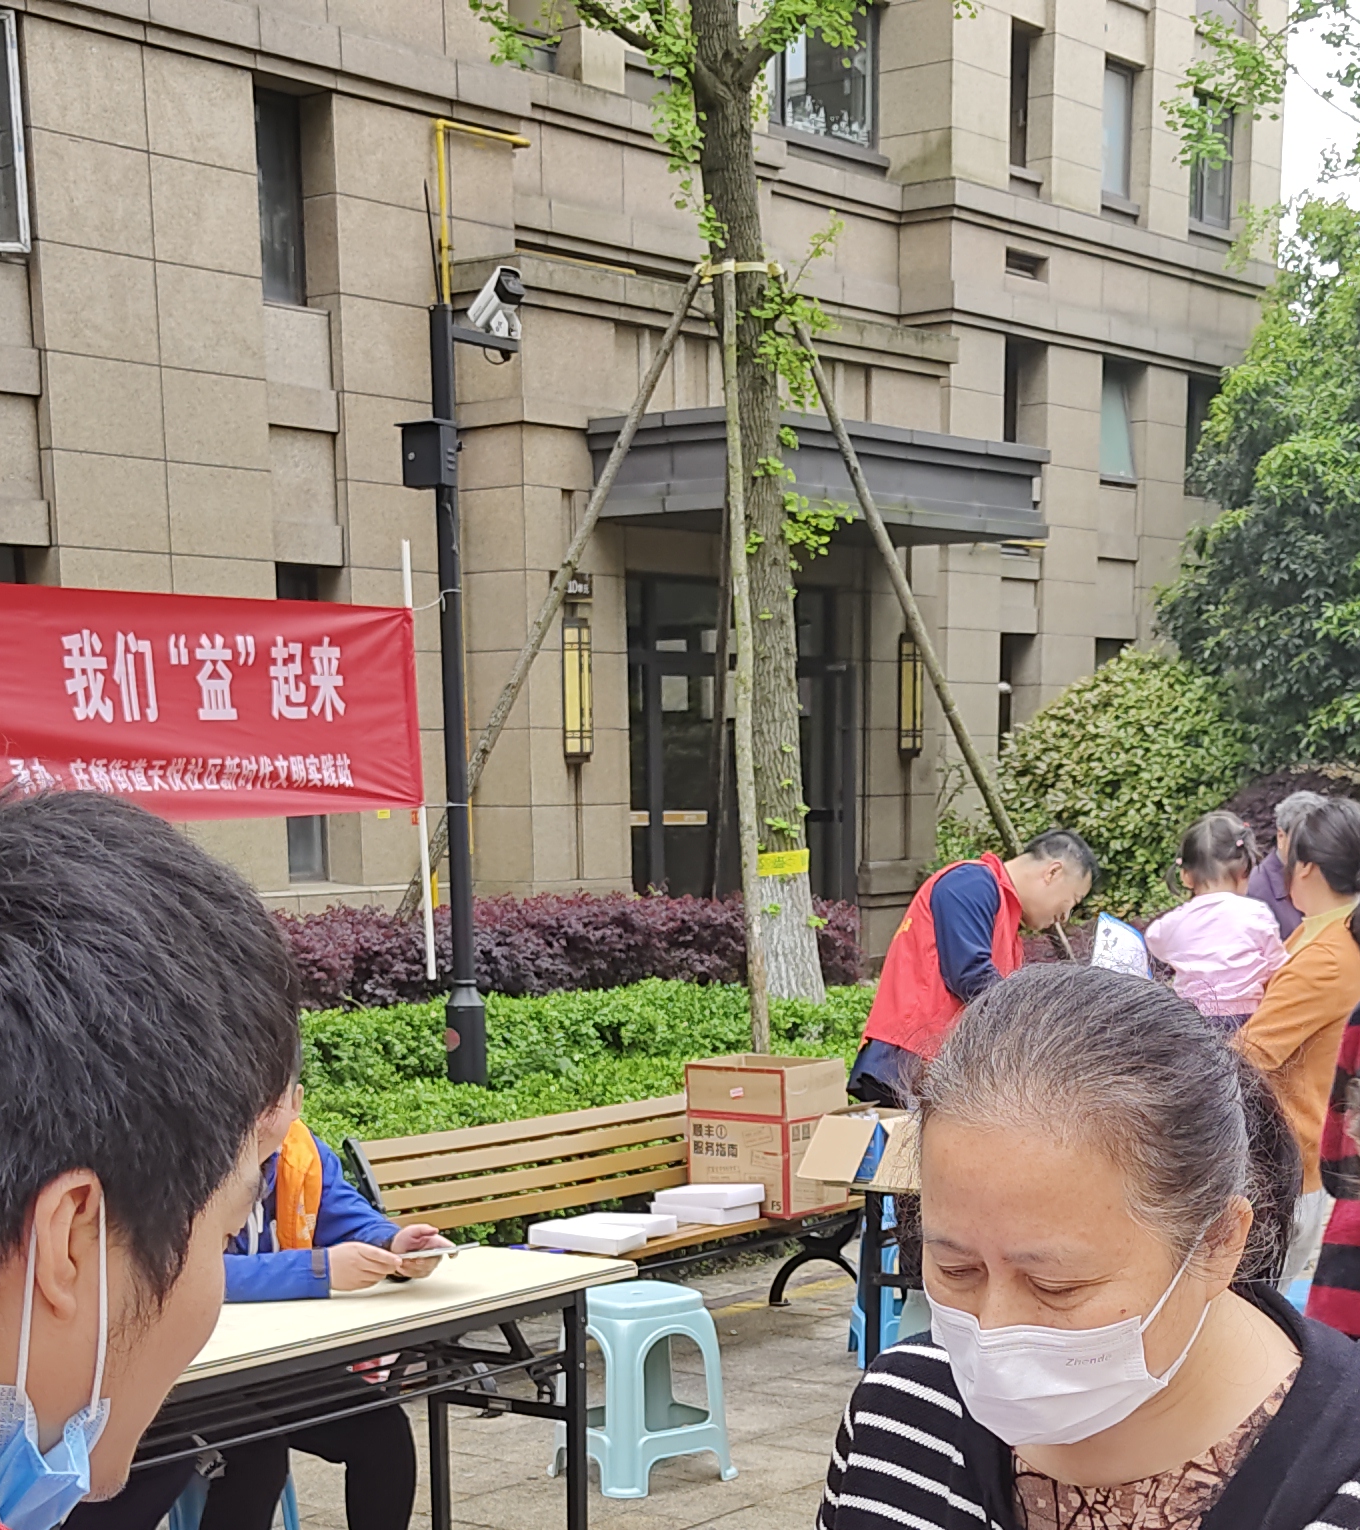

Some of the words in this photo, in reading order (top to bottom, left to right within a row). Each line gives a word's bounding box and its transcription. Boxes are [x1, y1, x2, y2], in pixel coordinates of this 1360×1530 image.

[693, 1141, 738, 1158] 服务指南
[771, 1200, 782, 1211] F5
